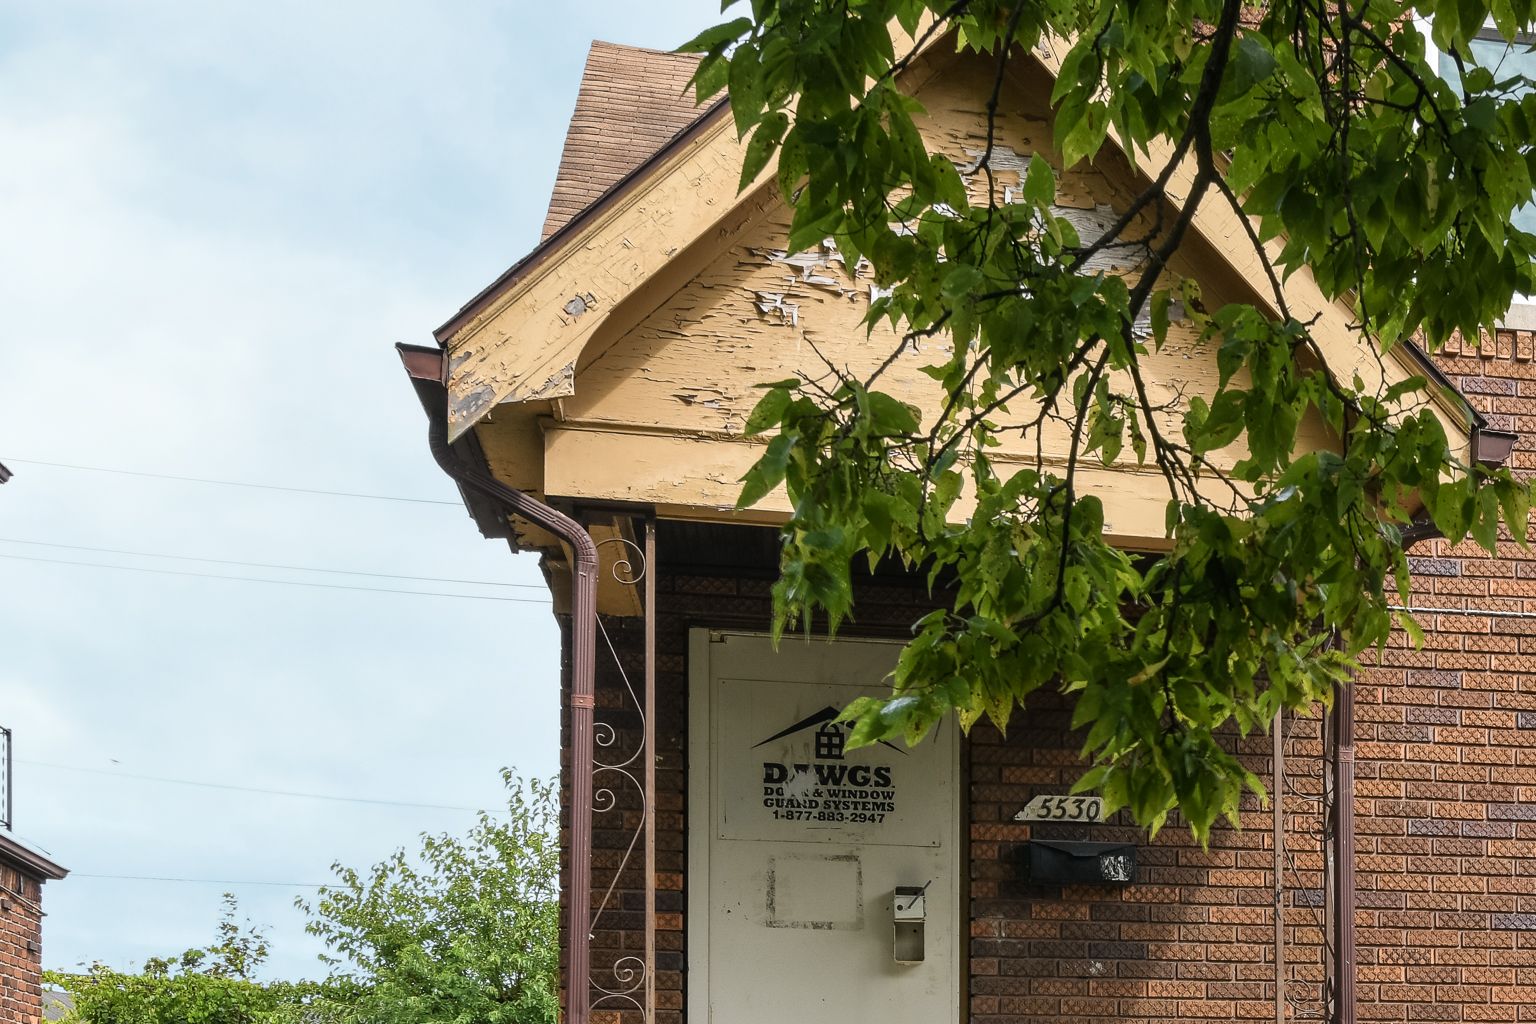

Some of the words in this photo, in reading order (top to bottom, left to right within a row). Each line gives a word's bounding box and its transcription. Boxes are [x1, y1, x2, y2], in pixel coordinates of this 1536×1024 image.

[812, 788, 823, 798] &
[826, 788, 895, 800] WINDOW
[823, 800, 895, 812] SYSTEMS
[1037, 797, 1100, 821] 5530
[772, 809, 885, 823] 1-877-883-2947
